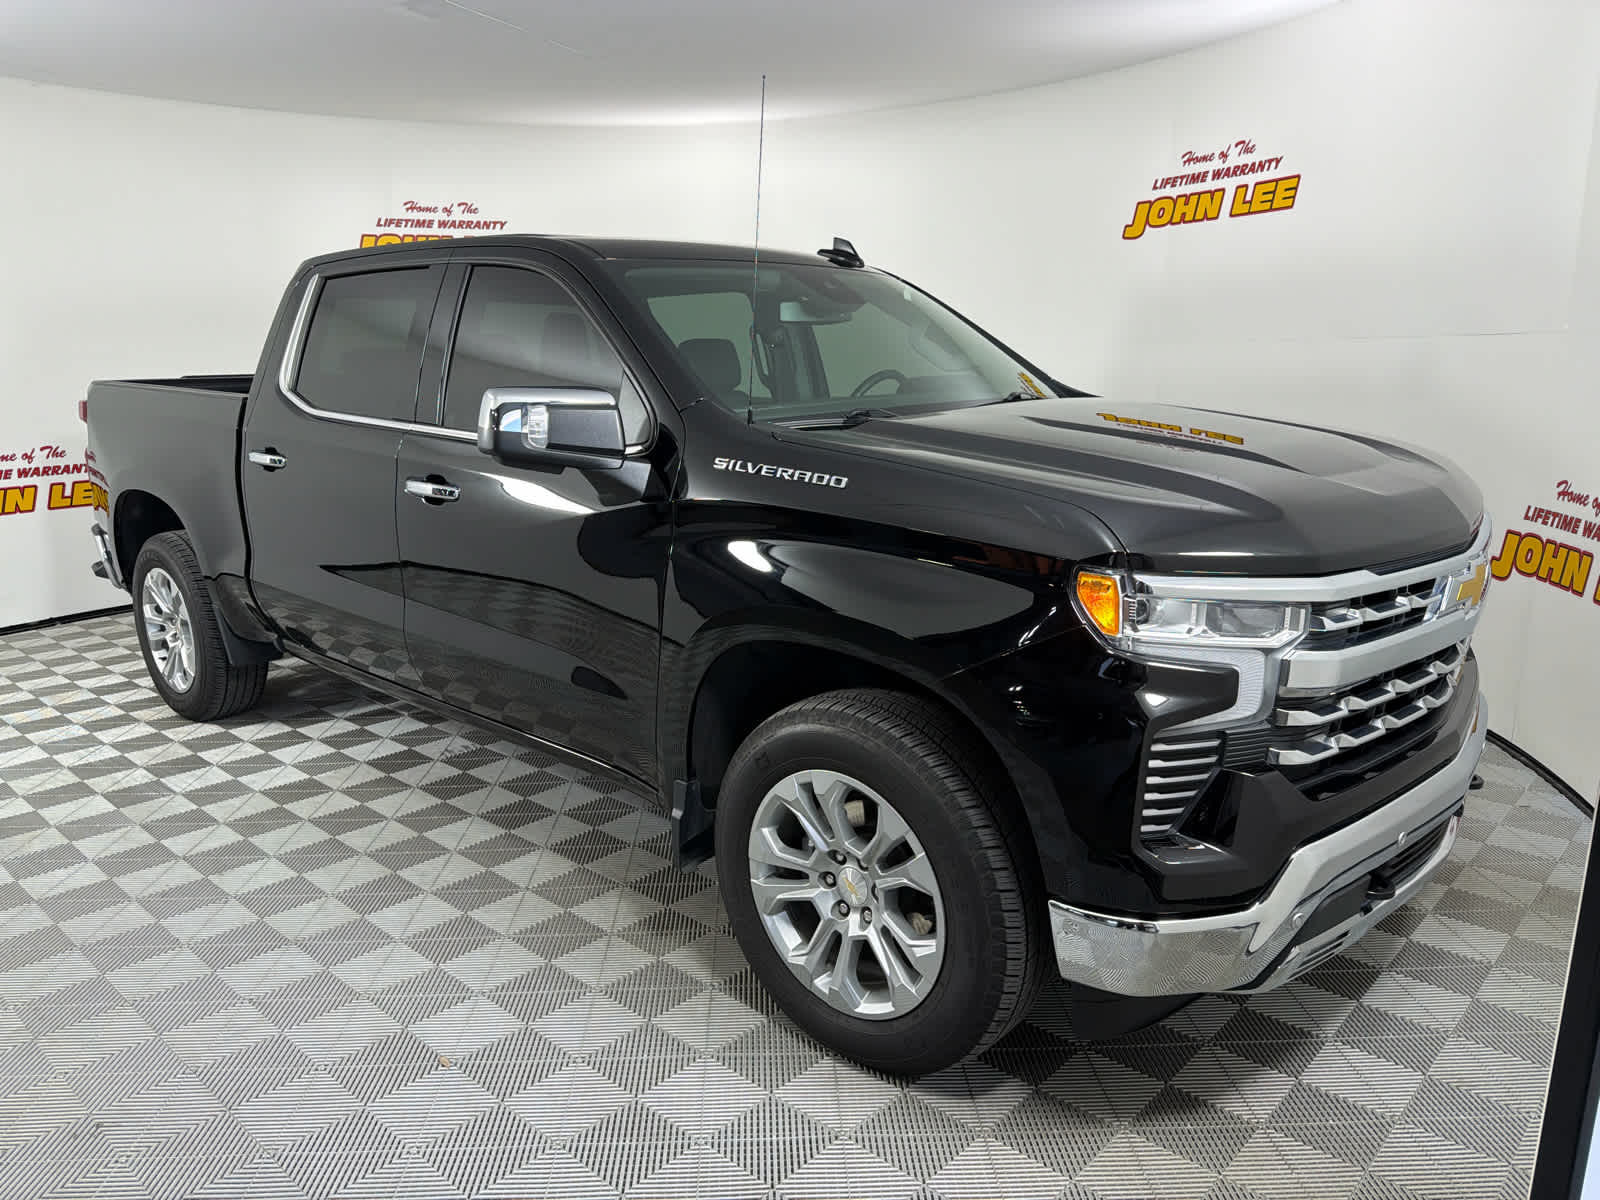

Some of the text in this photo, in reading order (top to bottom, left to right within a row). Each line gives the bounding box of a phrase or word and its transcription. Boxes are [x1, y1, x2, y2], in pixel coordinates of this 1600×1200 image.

[1181, 138, 1256, 167] Home of The
[1152, 156, 1284, 191] LIFETIME WARRANTY
[403, 200, 479, 216] Home of The
[1122, 174, 1301, 240] JOHN LEE
[376, 218, 507, 230] LIFETIME WARRANTY
[0, 445, 67, 464] me of The
[17, 463, 88, 479] WARRANT
[713, 457, 848, 488] SILVERADO
[47, 480, 93, 510] LE
[1556, 480, 1590, 507] Home
[1523, 505, 1582, 534] LIFETIME
[1490, 529, 1594, 597] JOHN
